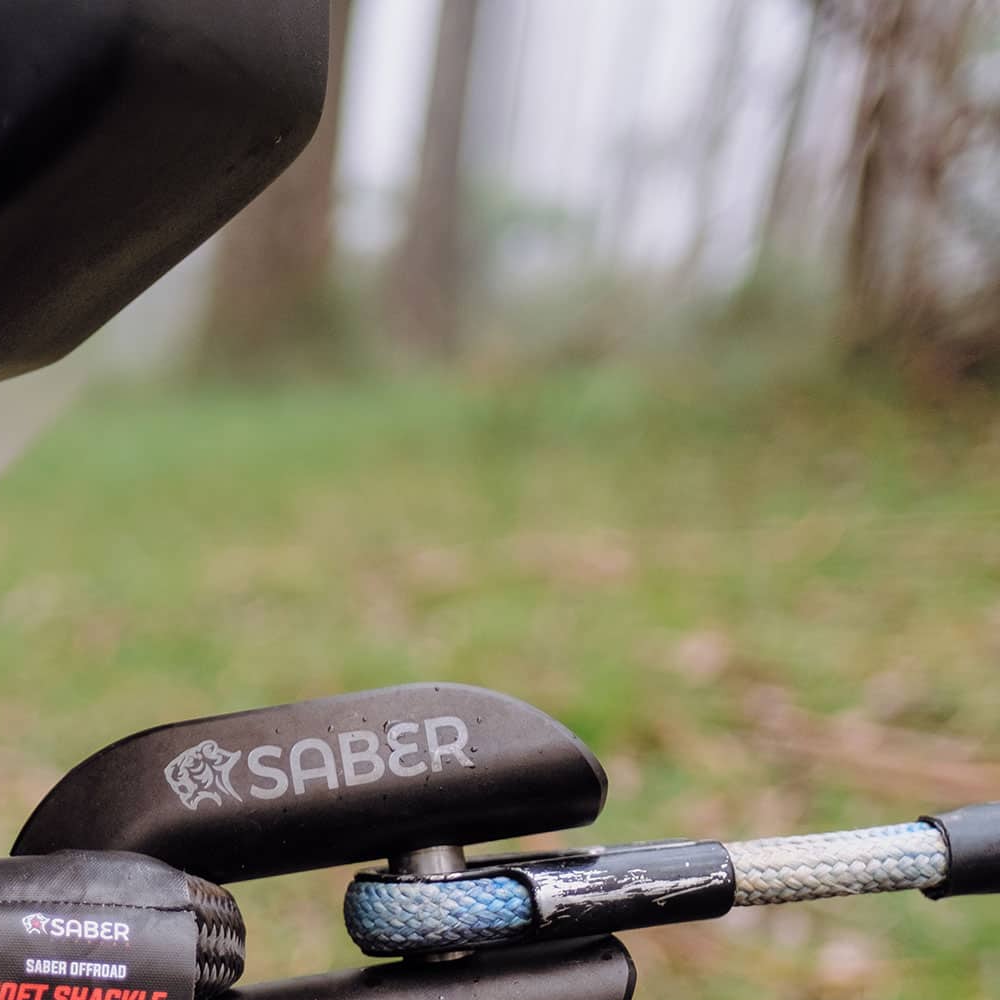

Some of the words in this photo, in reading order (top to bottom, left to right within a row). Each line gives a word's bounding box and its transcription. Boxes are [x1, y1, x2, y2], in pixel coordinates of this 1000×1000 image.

[247, 716, 475, 799] SABER
[50, 918, 129, 940] SABER
[26, 959, 66, 975] SABER
[70, 961, 126, 978] OFFROAD
